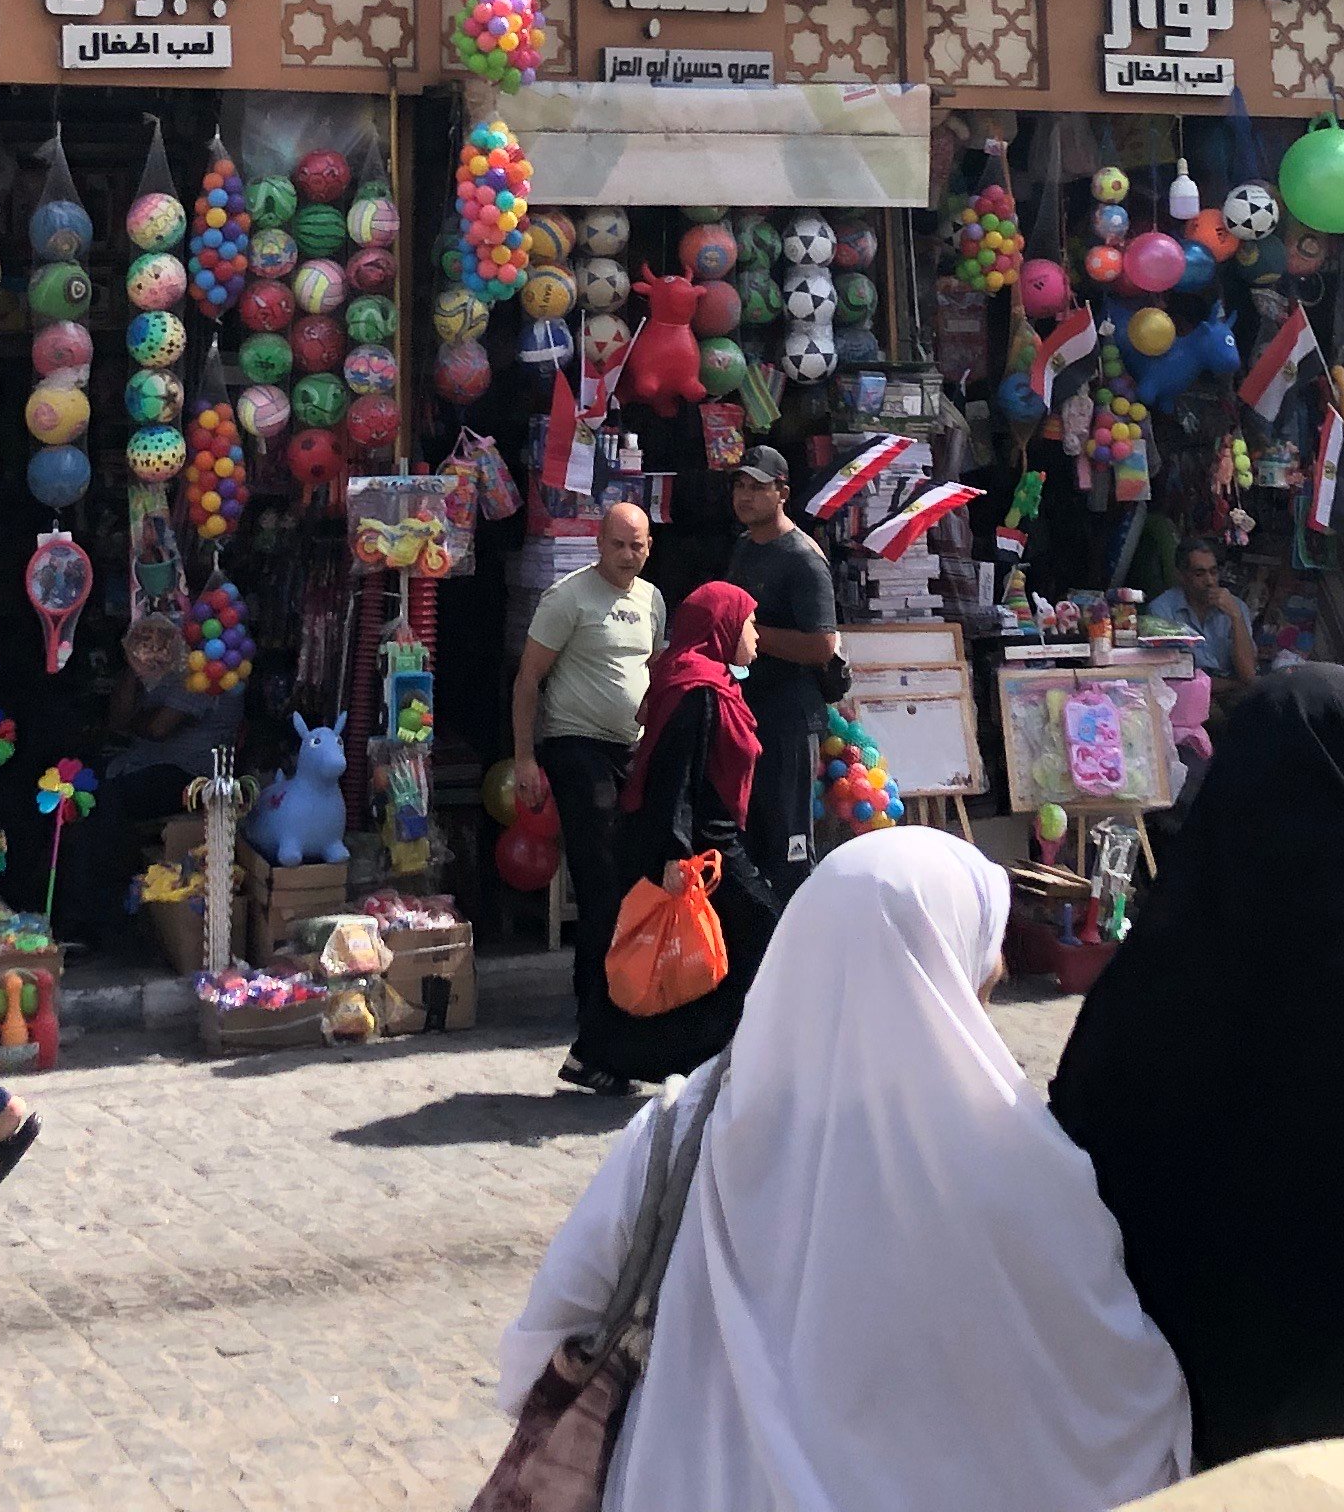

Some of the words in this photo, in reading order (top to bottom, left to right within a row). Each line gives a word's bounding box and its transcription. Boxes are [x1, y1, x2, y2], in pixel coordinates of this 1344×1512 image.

[78, 31, 159, 61] اطفال
[166, 31, 214, 60] لعب
[608, 55, 643, 83] العز
[672, 55, 724, 83] حسين
[727, 62, 770, 84] عمرو
[1117, 61, 1179, 86] اطفال
[1184, 64, 1223, 88] لعب
